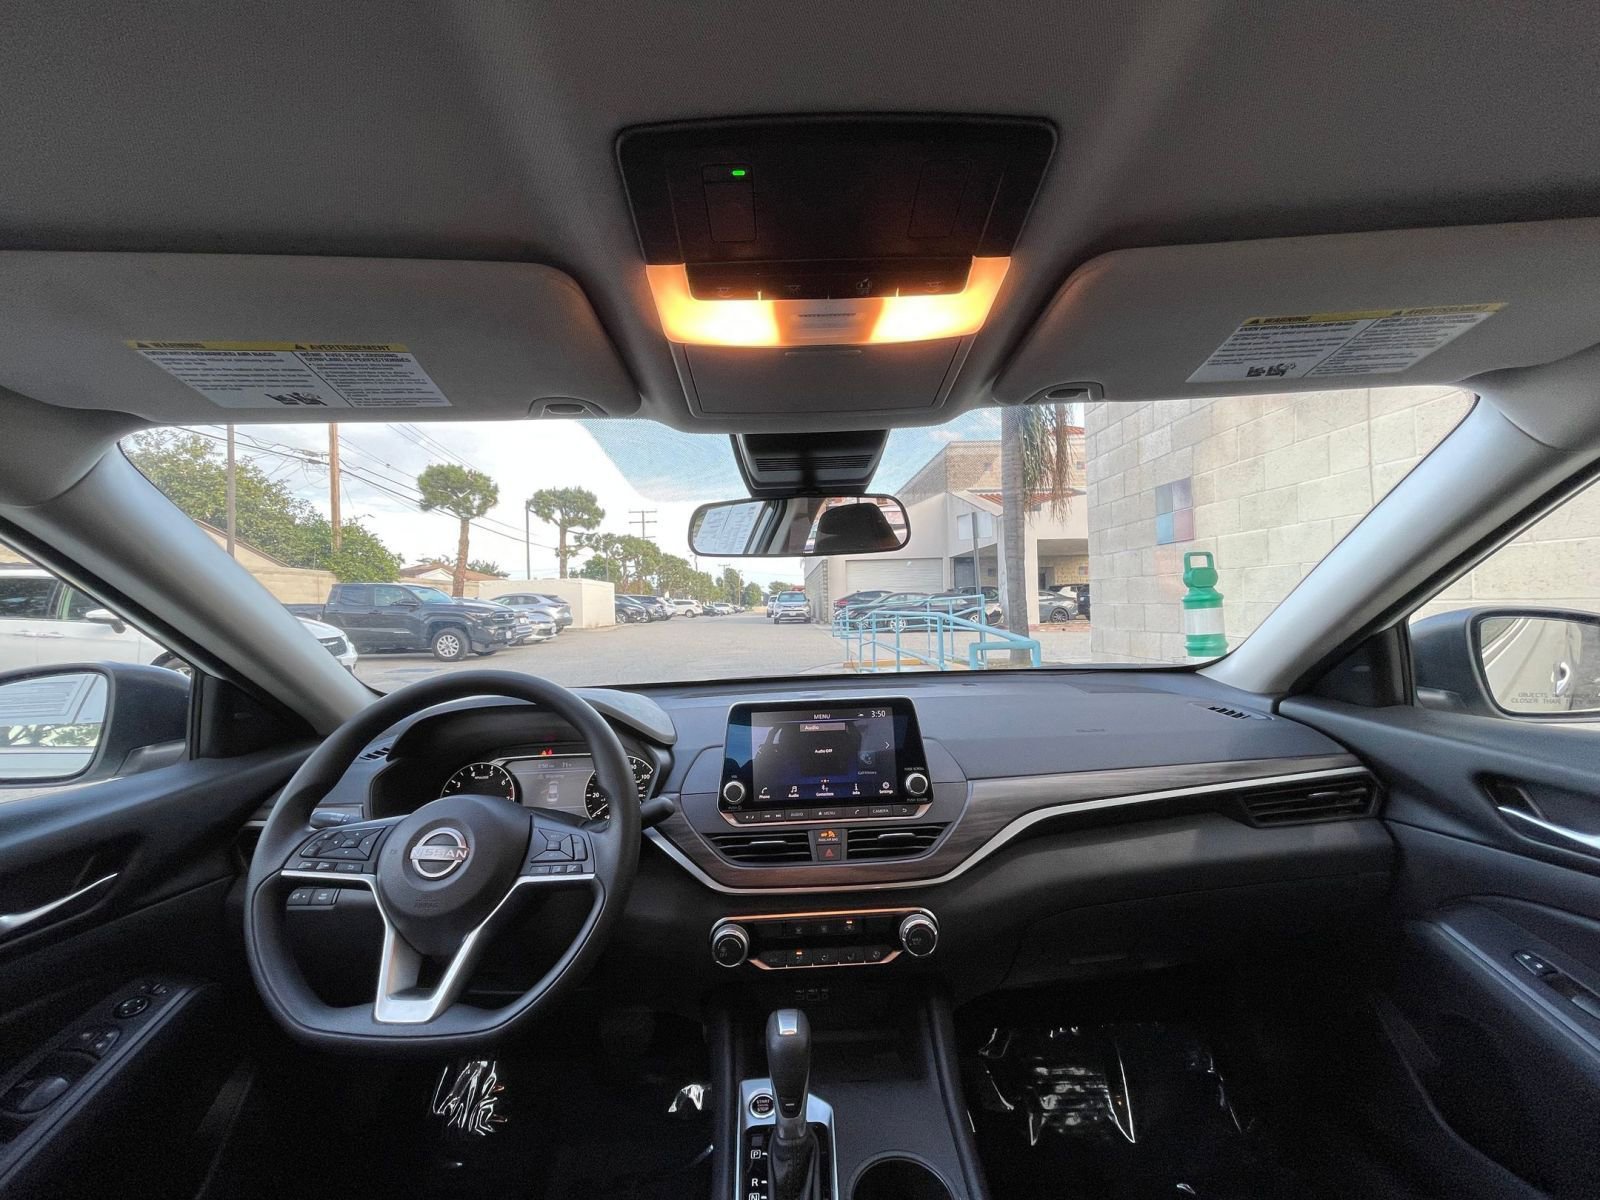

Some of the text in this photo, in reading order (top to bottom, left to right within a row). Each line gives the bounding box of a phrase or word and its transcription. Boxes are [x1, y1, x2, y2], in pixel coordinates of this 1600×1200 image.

[871, 710, 886, 718] 3:50
[412, 848, 468, 859] NISSAN
[751, 1178, 759, 1187] R
